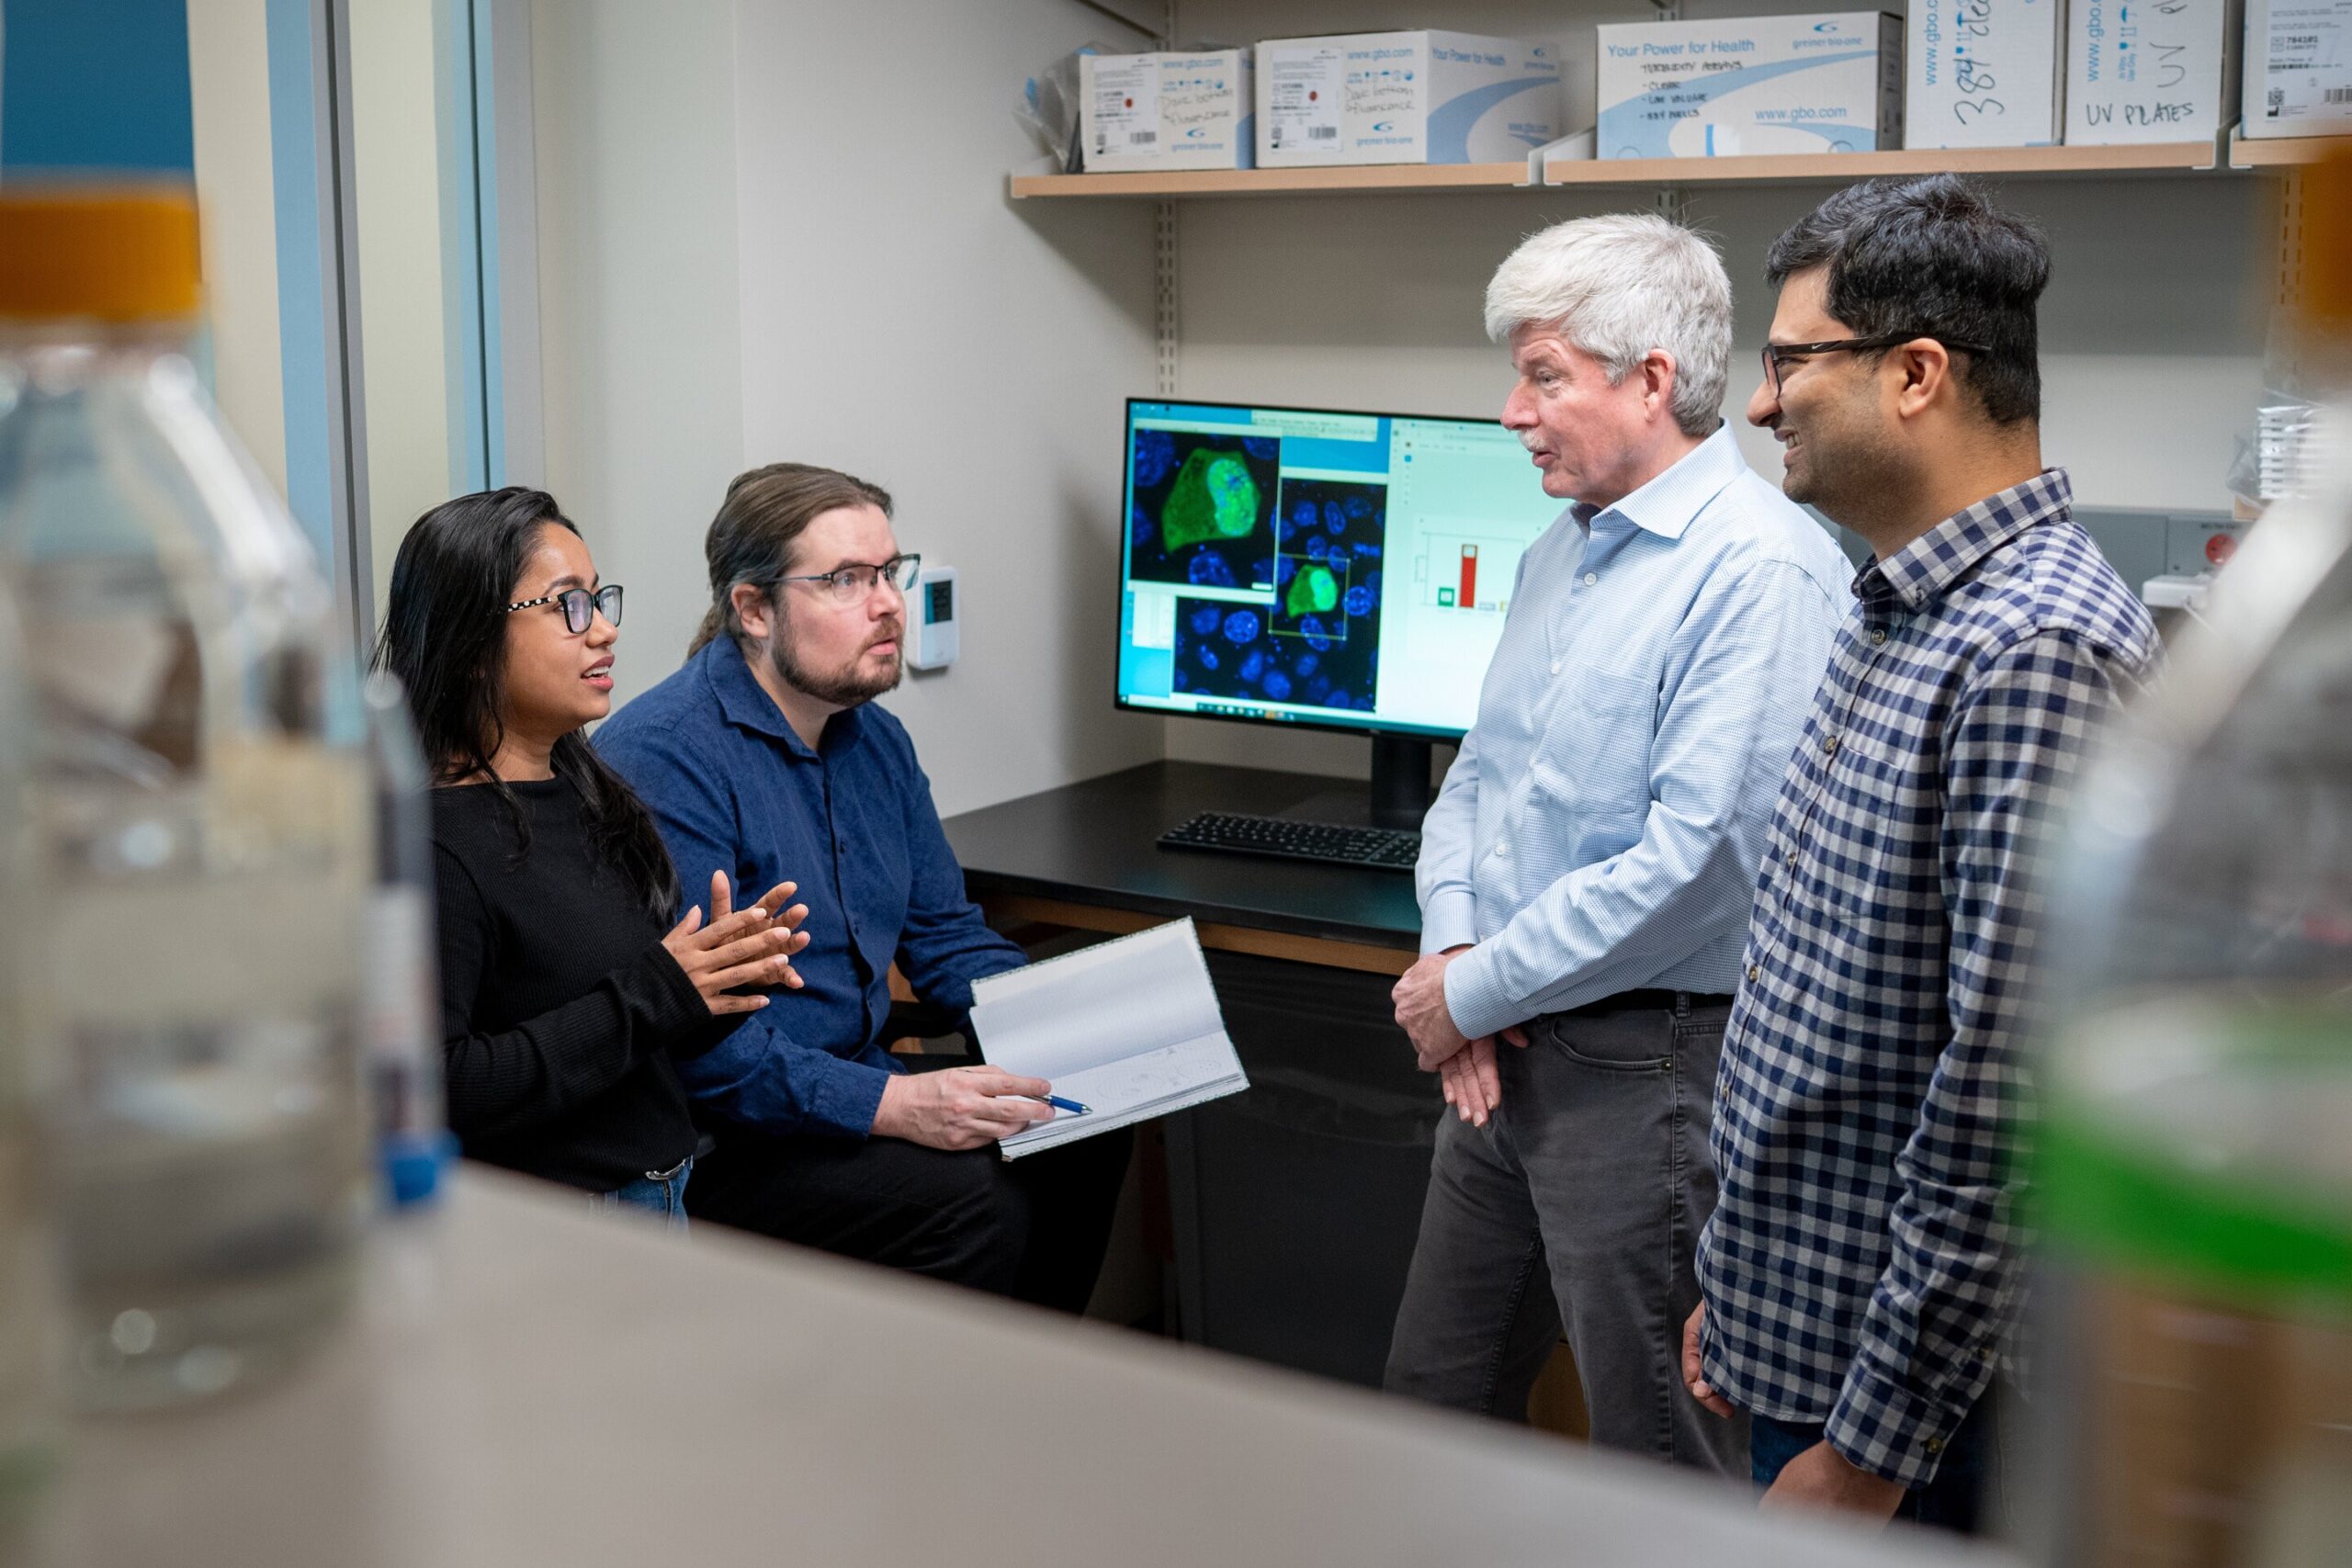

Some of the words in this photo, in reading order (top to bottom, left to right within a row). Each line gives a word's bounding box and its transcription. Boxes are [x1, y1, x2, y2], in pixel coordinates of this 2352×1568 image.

[1608, 44, 1638, 58] Your
[1643, 43, 1684, 56] Power
[1689, 40, 1707, 53] for
[1711, 39, 1756, 52] Health
[1792, 38, 1826, 49] greiner
[2086, 0, 2105, 82] www.gbo.
[1755, 106, 1848, 122] www.gbo.com
[2086, 103, 2113, 126] UV
[2124, 102, 2194, 126] PLATES
